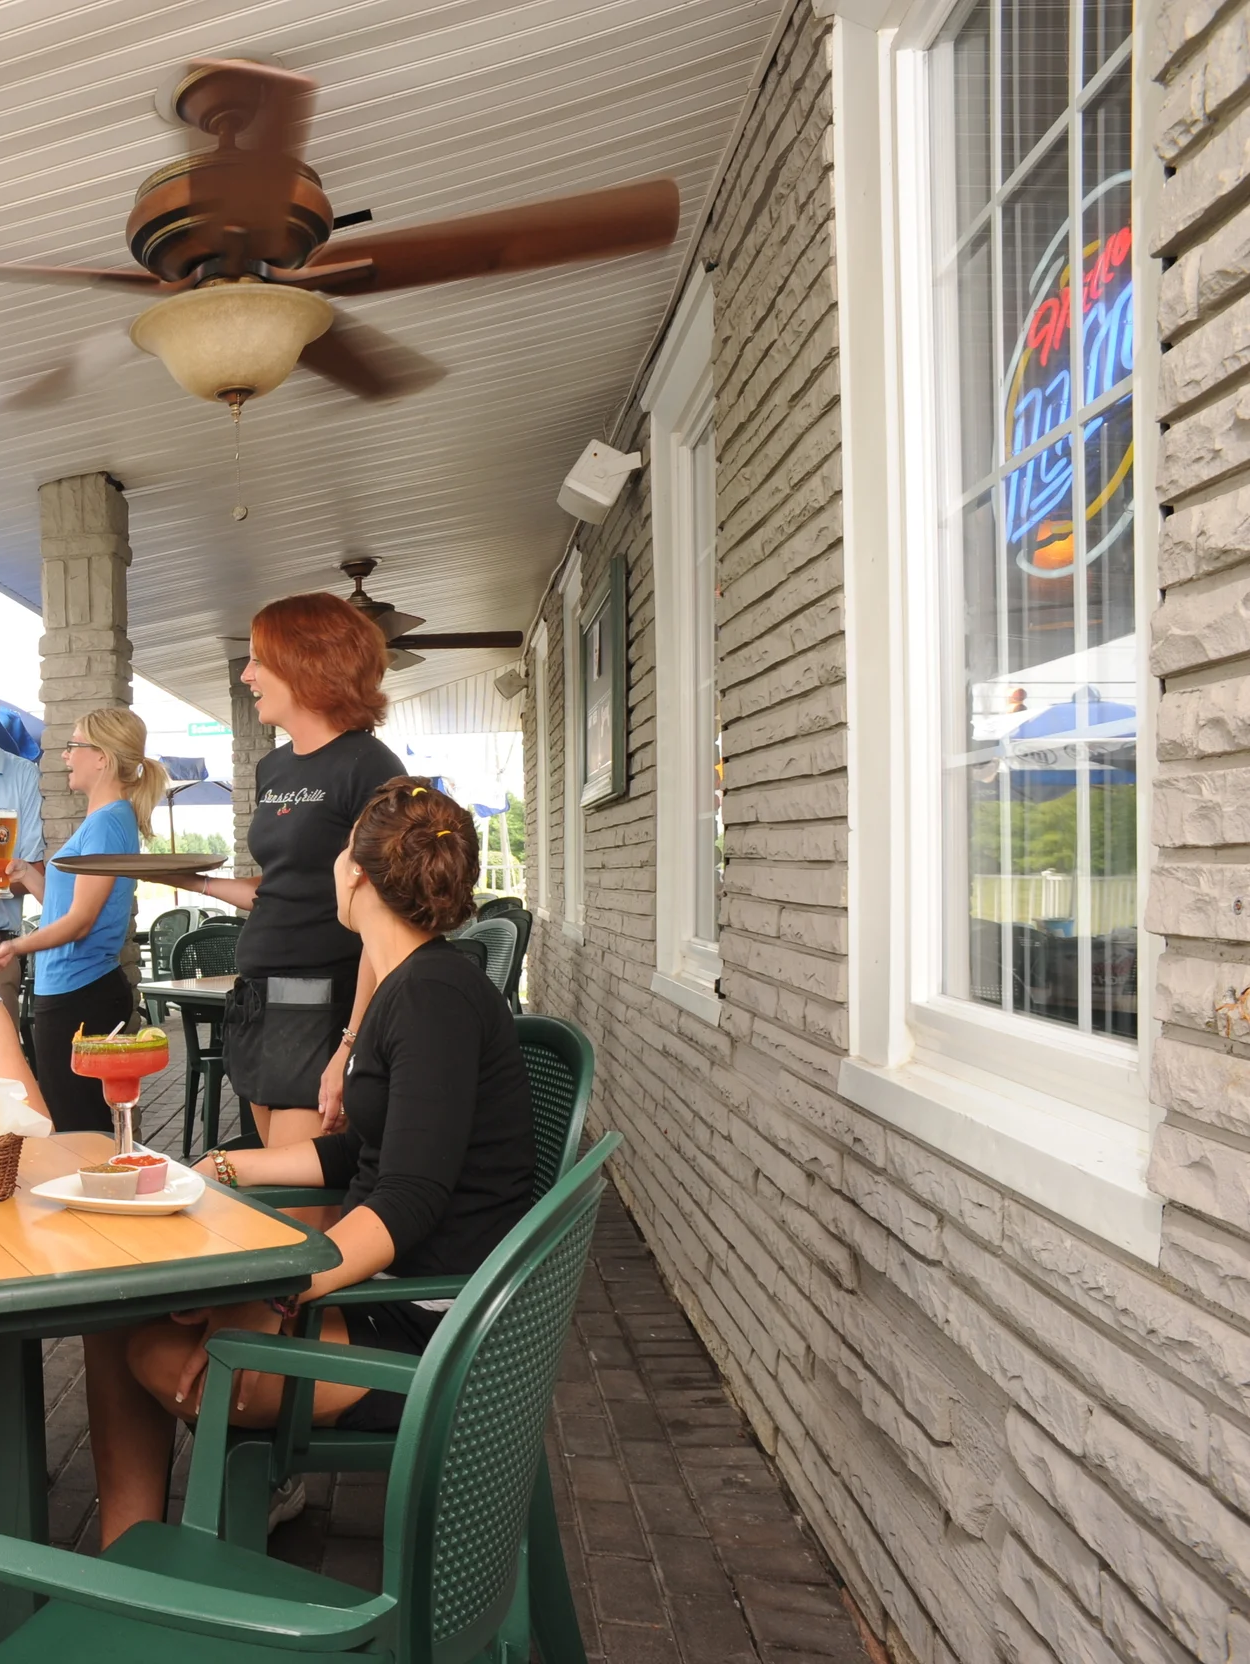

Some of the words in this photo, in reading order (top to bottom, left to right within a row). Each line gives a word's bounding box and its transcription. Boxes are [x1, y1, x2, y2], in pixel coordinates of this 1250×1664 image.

[1027, 227, 1132, 367] Mille
[260, 789, 295, 804] Sunset
[295, 787, 326, 805] Grille
